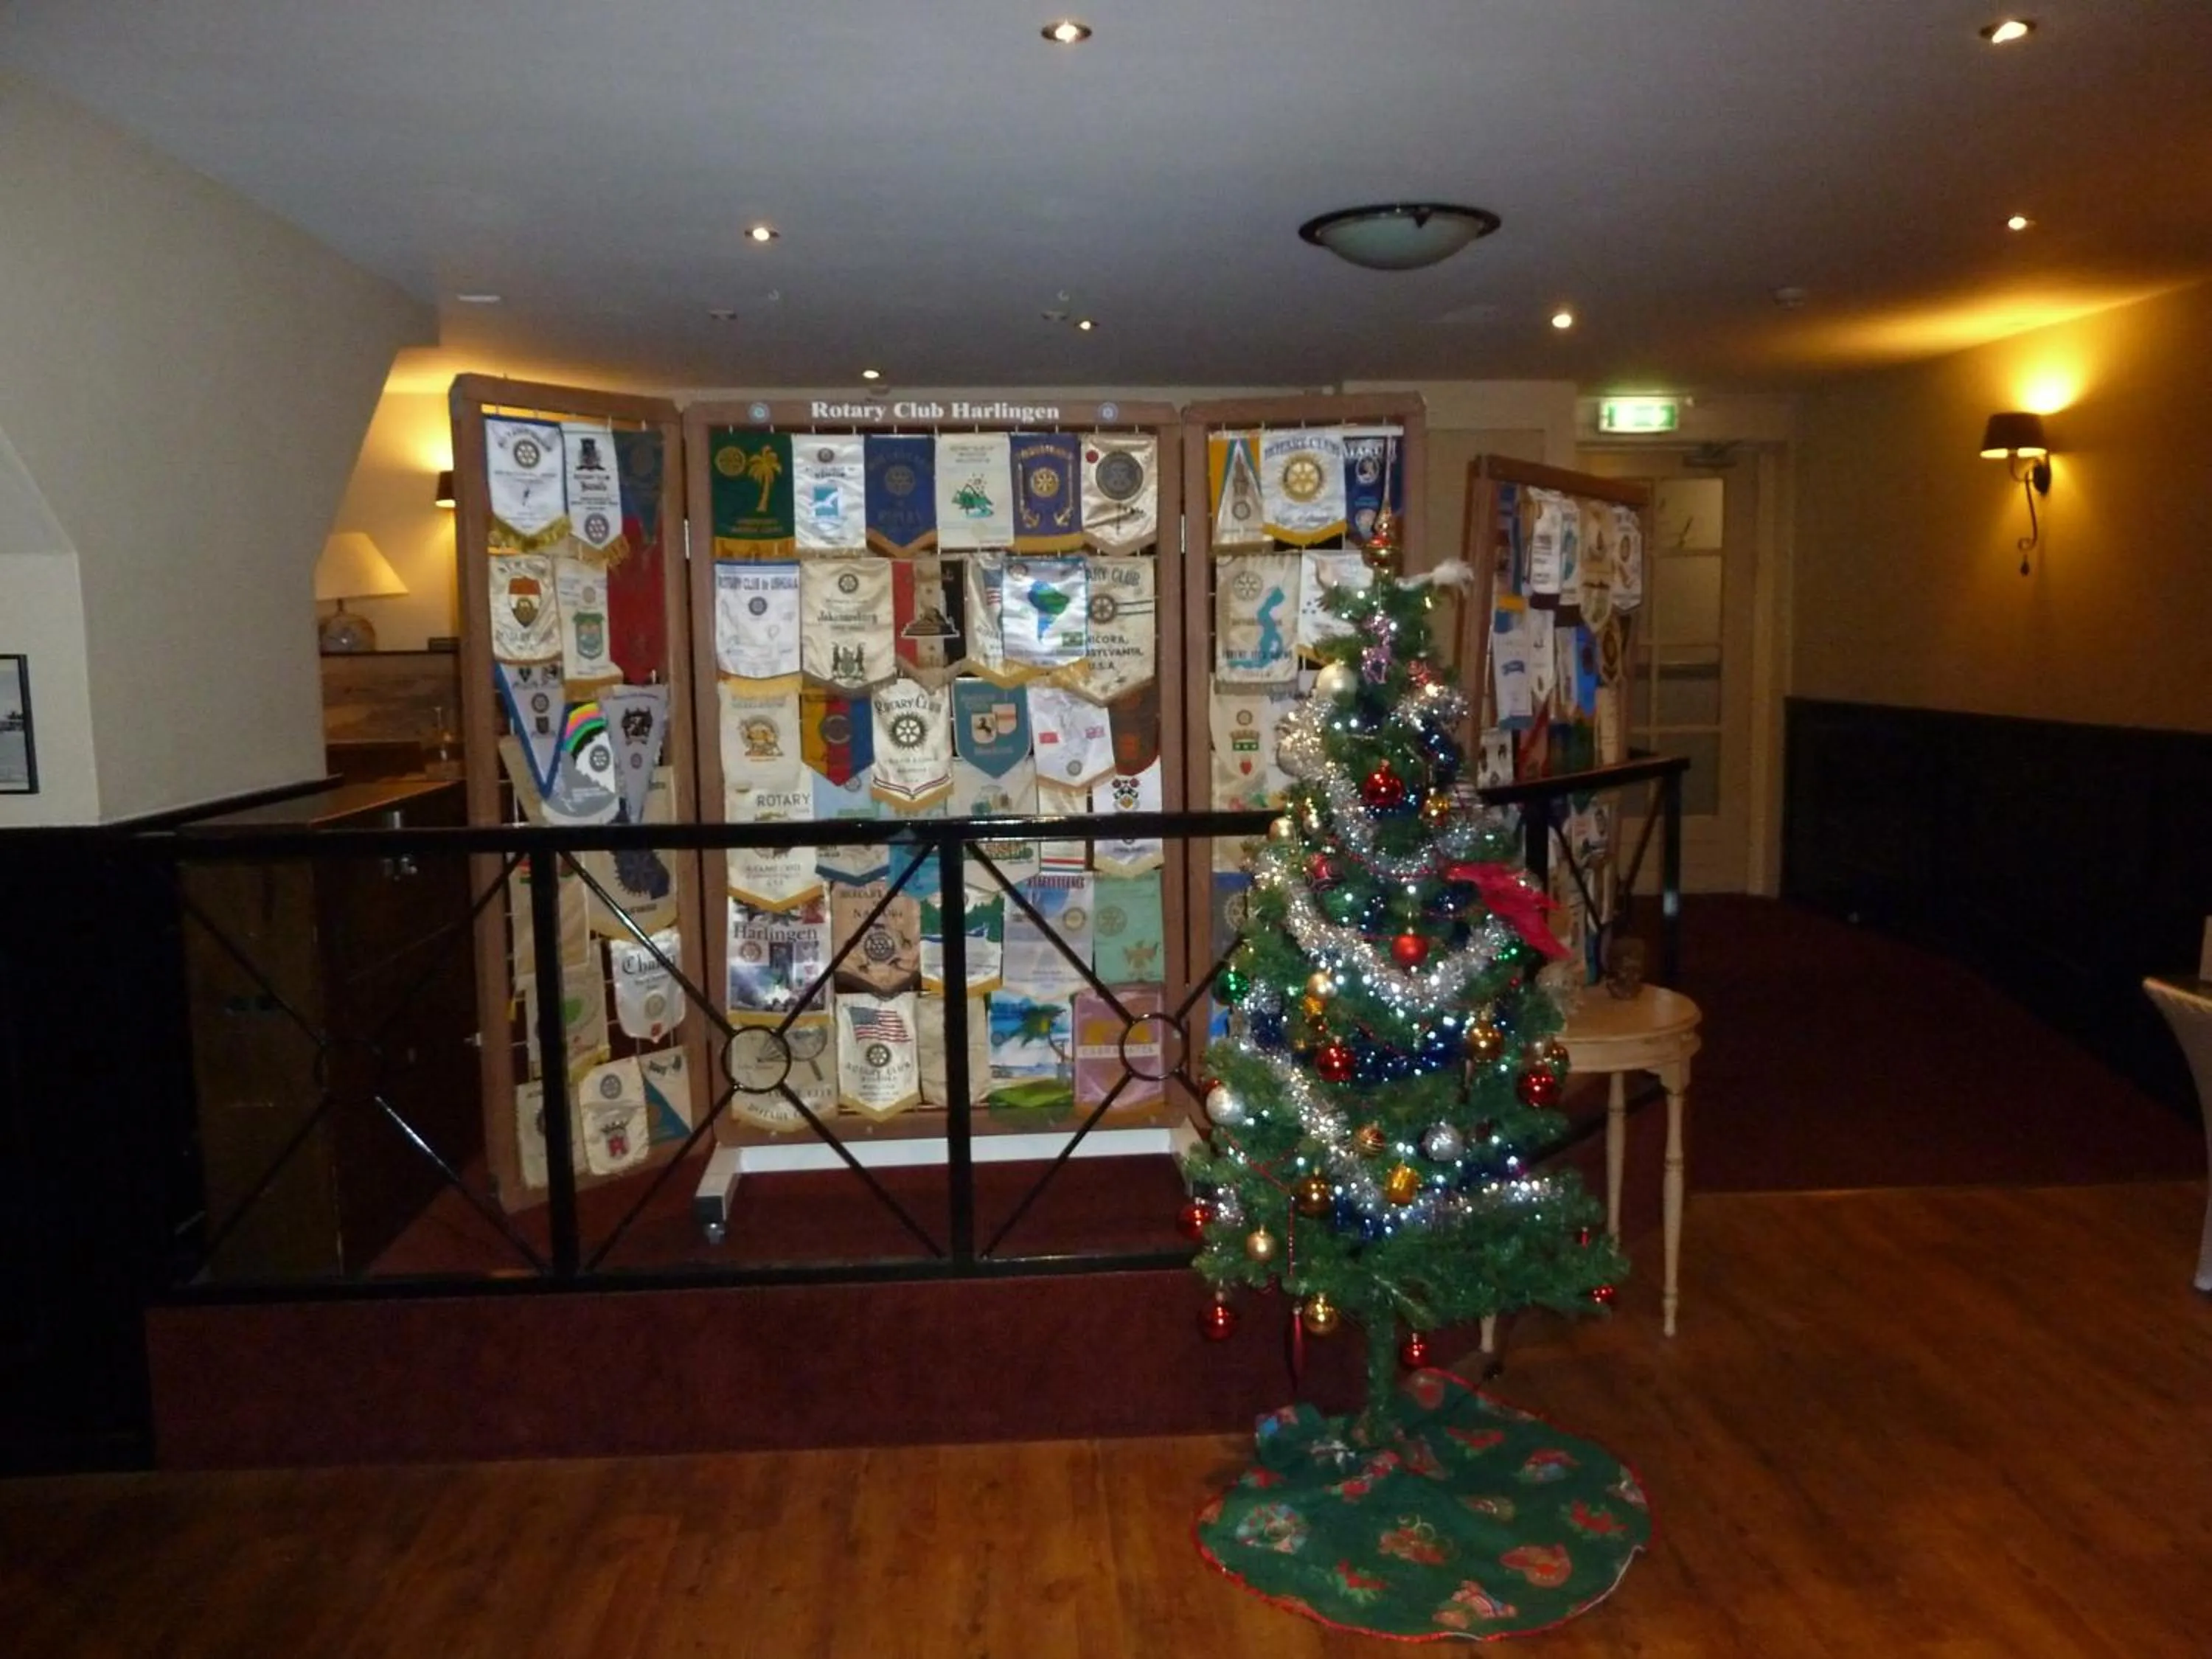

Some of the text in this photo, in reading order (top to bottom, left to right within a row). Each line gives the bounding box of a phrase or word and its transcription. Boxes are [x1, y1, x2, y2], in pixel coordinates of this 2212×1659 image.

[811, 402, 1060, 423] Rotary Club Harlingen
[1111, 566, 1141, 586] CLUB
[874, 698, 914, 715] ROTARY
[757, 793, 811, 807] ROTARY
[733, 920, 818, 942] Harlingen
